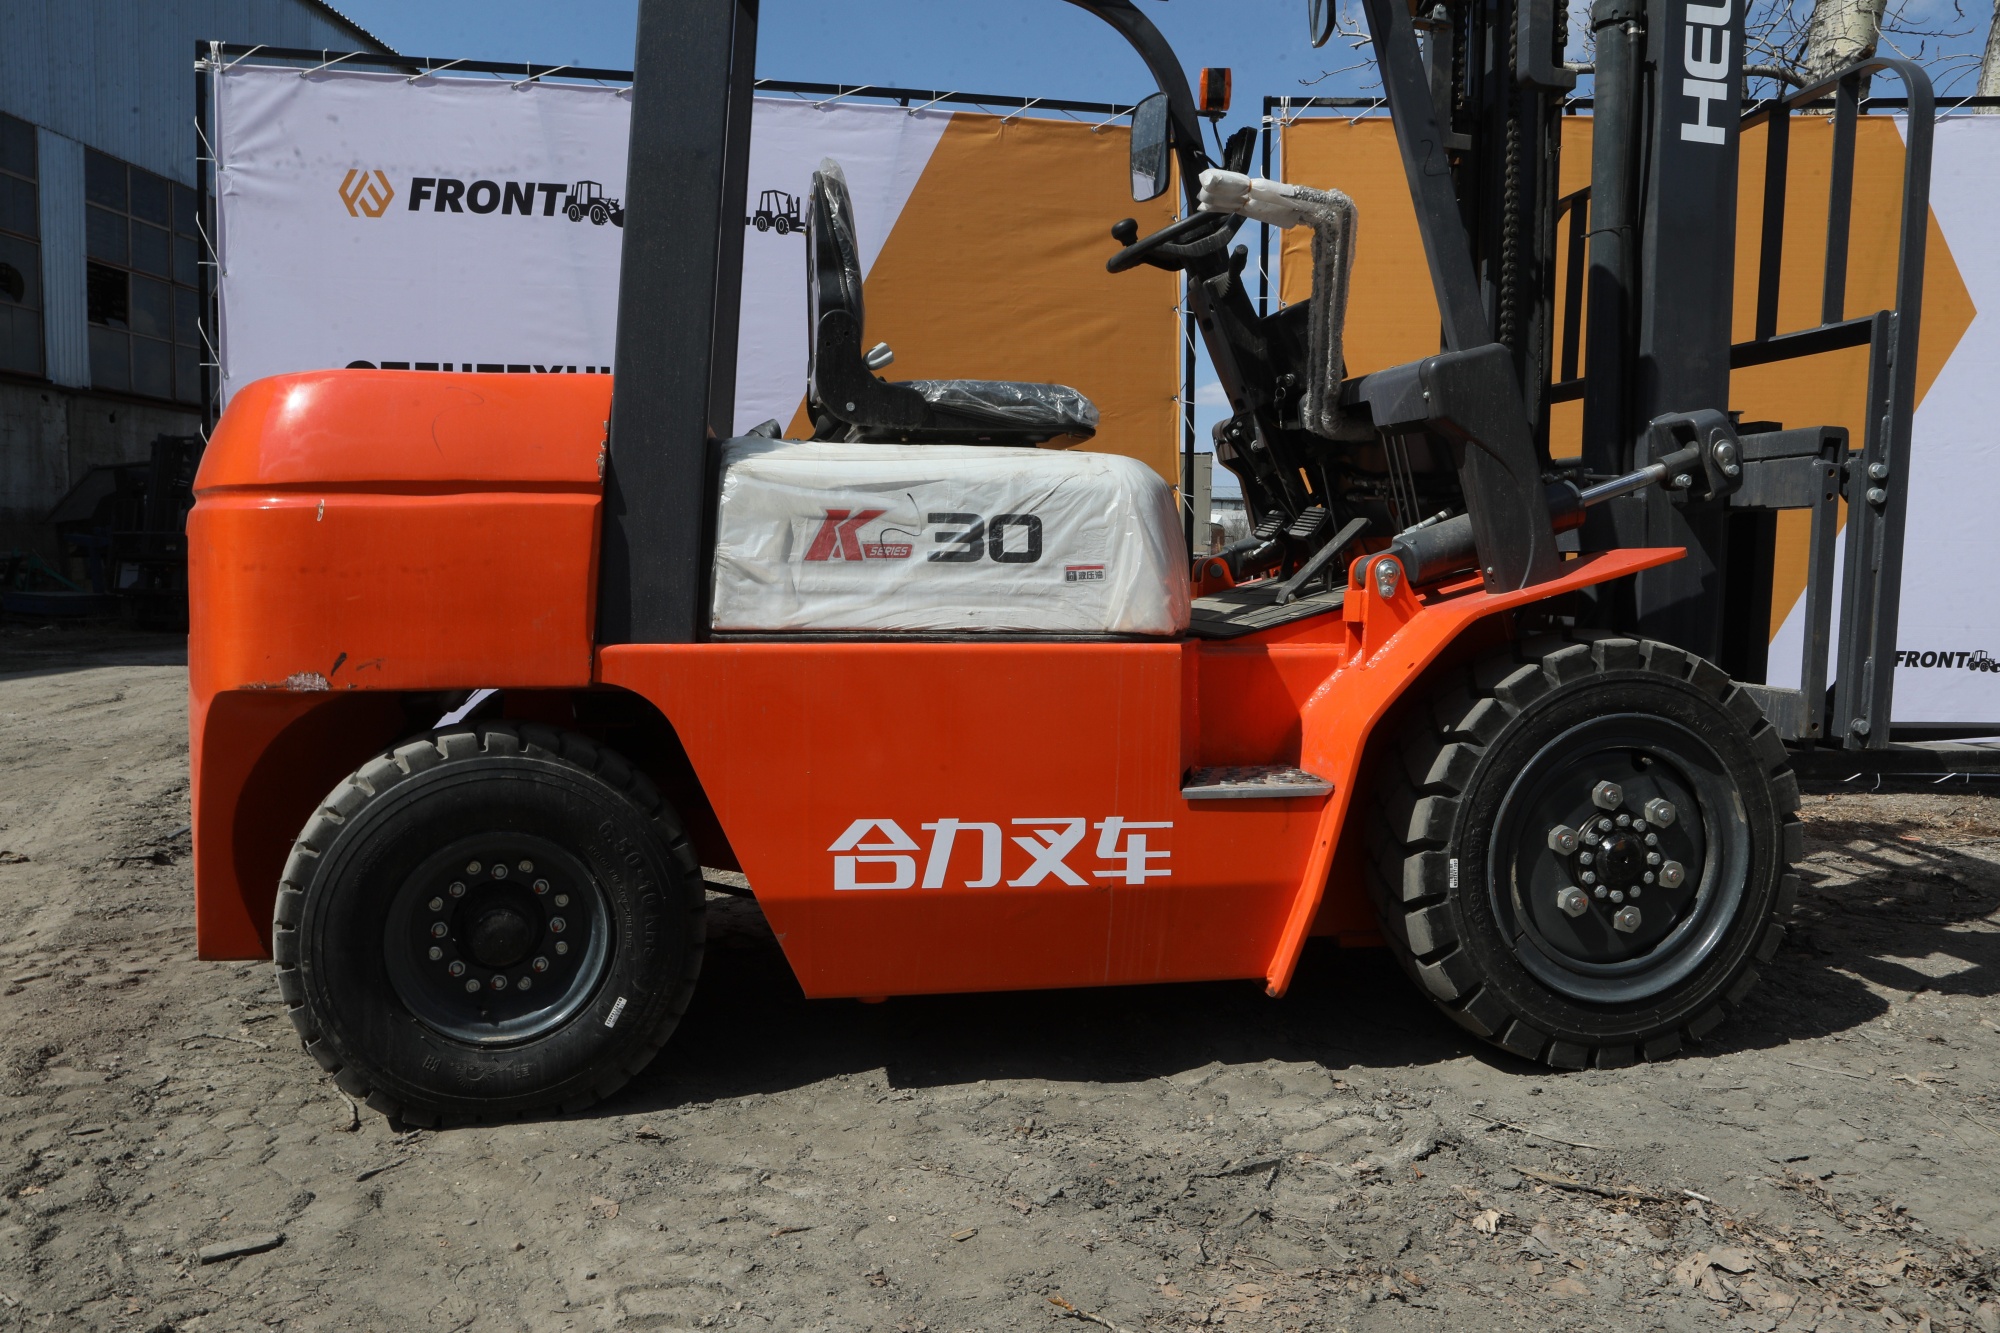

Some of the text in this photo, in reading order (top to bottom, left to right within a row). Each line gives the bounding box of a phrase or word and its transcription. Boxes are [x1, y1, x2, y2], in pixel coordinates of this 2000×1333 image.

[408, 177, 567, 216] FRONT
[804, 509, 1043, 563] K SERIES 30
[1894, 651, 1969, 668] FRONT
[826, 816, 1174, 890] 合力叉车
